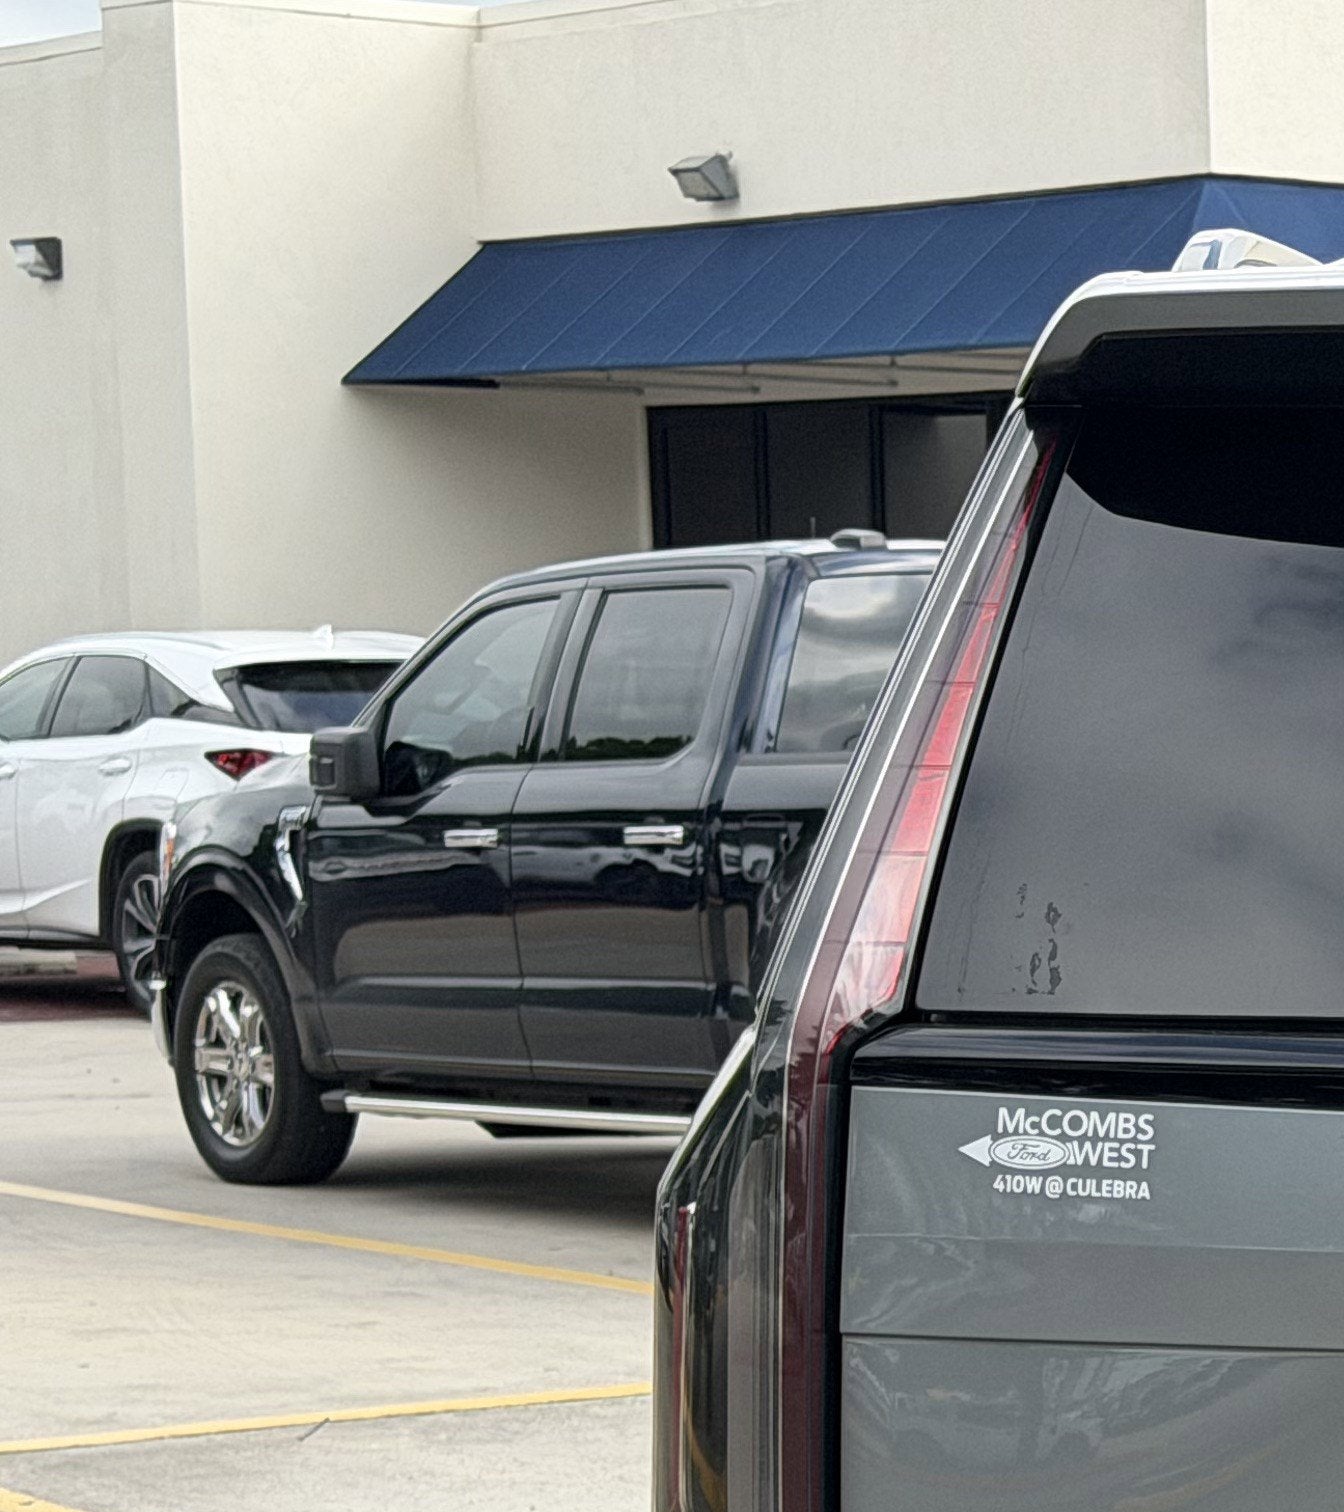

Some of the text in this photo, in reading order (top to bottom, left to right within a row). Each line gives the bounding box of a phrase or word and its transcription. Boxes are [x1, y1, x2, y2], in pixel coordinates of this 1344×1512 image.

[997, 1107, 1155, 1140] McCOMBS
[1006, 1140, 1156, 1169] Ford WEST
[992, 1174, 1151, 1200] 410W @ CULEBRA
